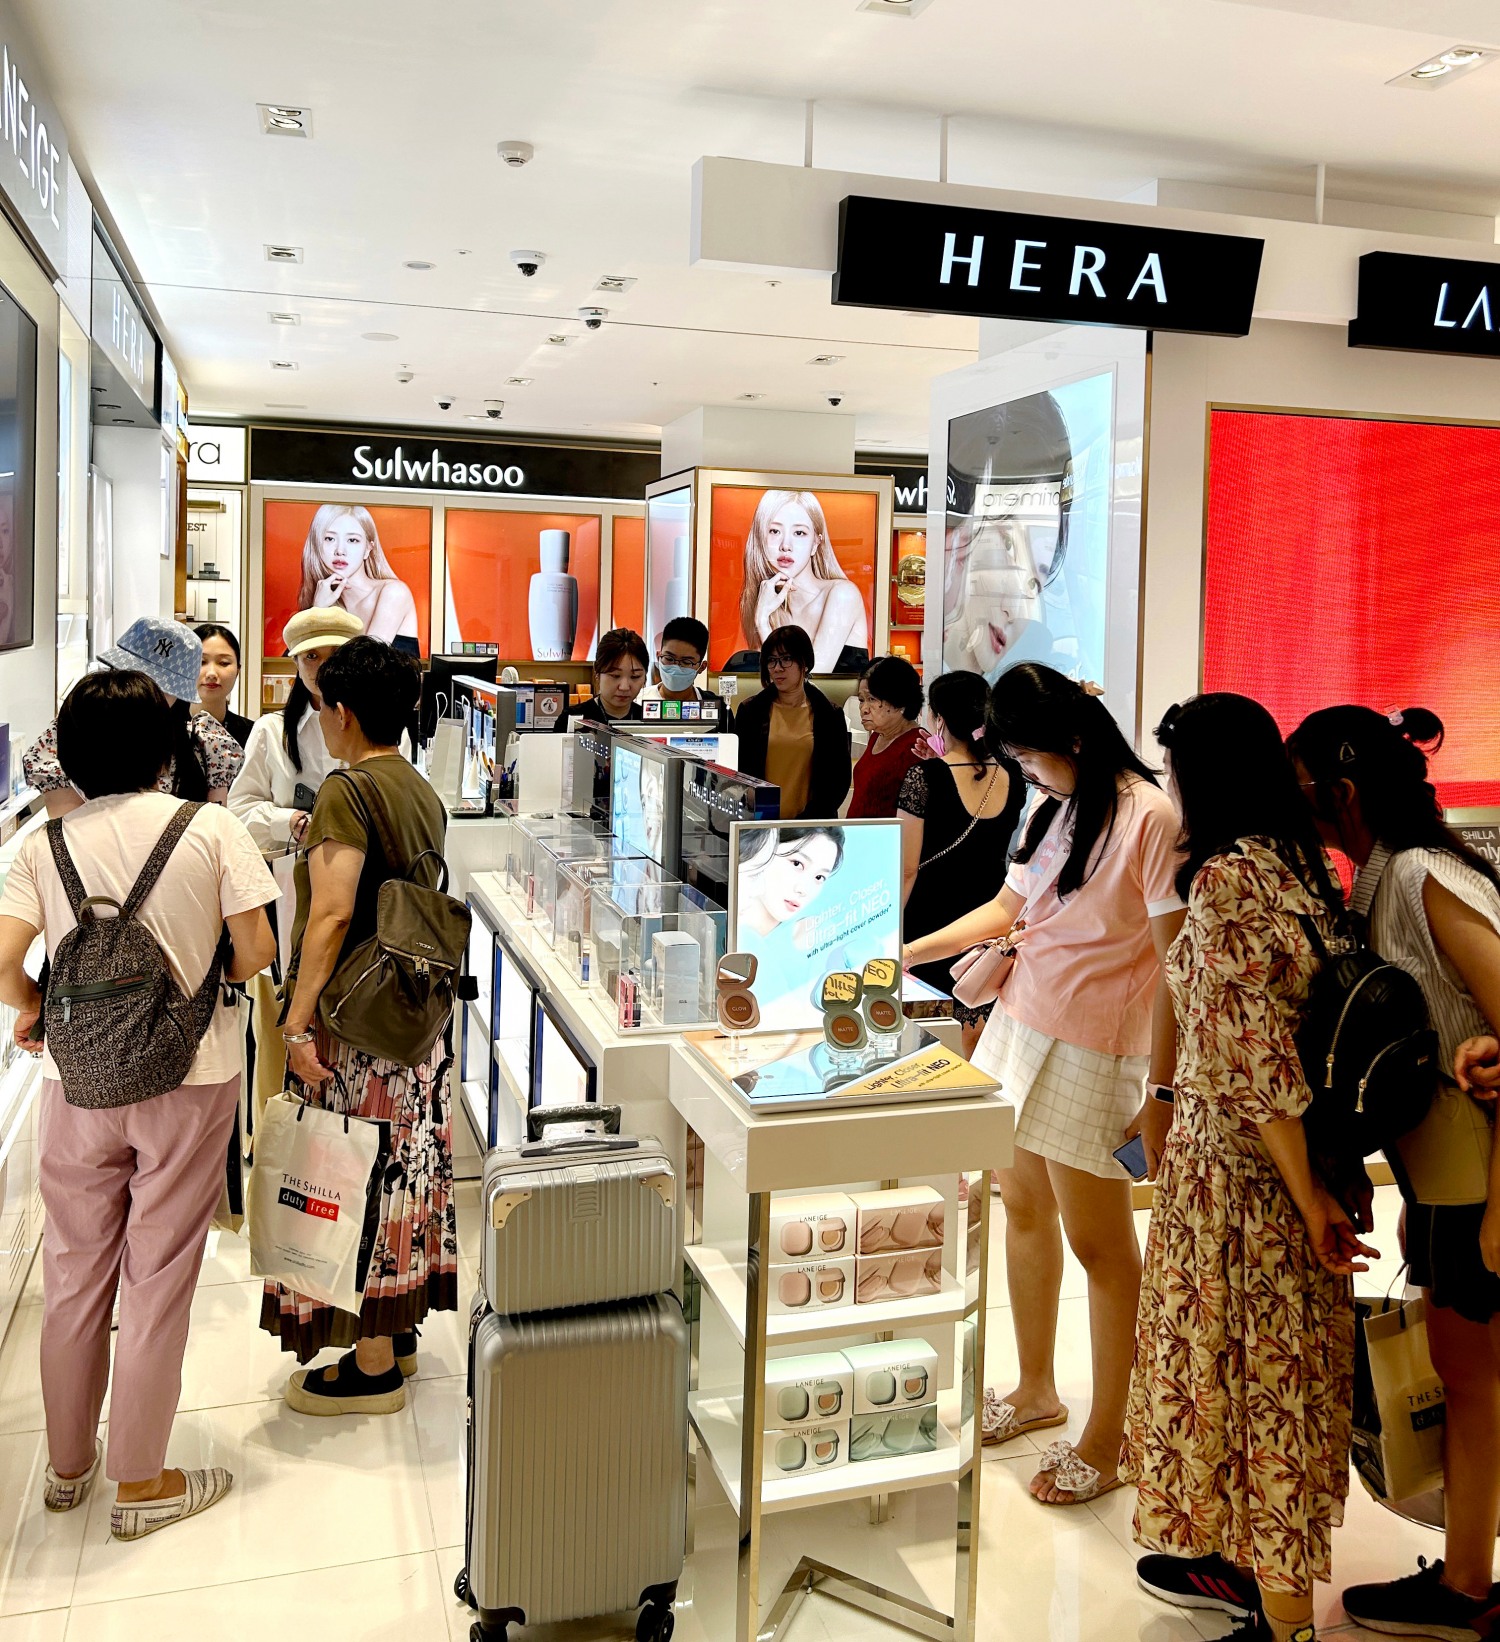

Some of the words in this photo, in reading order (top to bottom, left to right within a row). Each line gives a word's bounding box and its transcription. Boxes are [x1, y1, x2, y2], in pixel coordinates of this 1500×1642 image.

[0, 44, 60, 231] NEIGE
[939, 231, 1168, 304] HERA
[1433, 282, 1500, 332] LA
[112, 286, 144, 385] HERA
[352, 445, 524, 487] Sulwhasoo
[153, 637, 175, 658] NY
[1461, 830, 1496, 840] SHILLA
[861, 889, 891, 918] NEO
[926, 1058, 951, 1072] NEO
[282, 1173, 302, 1188] THE
[303, 1180, 341, 1201] SHILLA
[282, 1191, 305, 1210] duty
[310, 1201, 335, 1217] free
[800, 1214, 828, 1223] LANEIGE
[797, 1264, 827, 1274] LANEIGE
[883, 1363, 911, 1373] LANEIGE
[795, 1378, 824, 1388] LANEIGE
[1406, 1391, 1432, 1407] THE
[1434, 1386, 1446, 1399] S
[793, 1427, 822, 1438] LANEIGE
